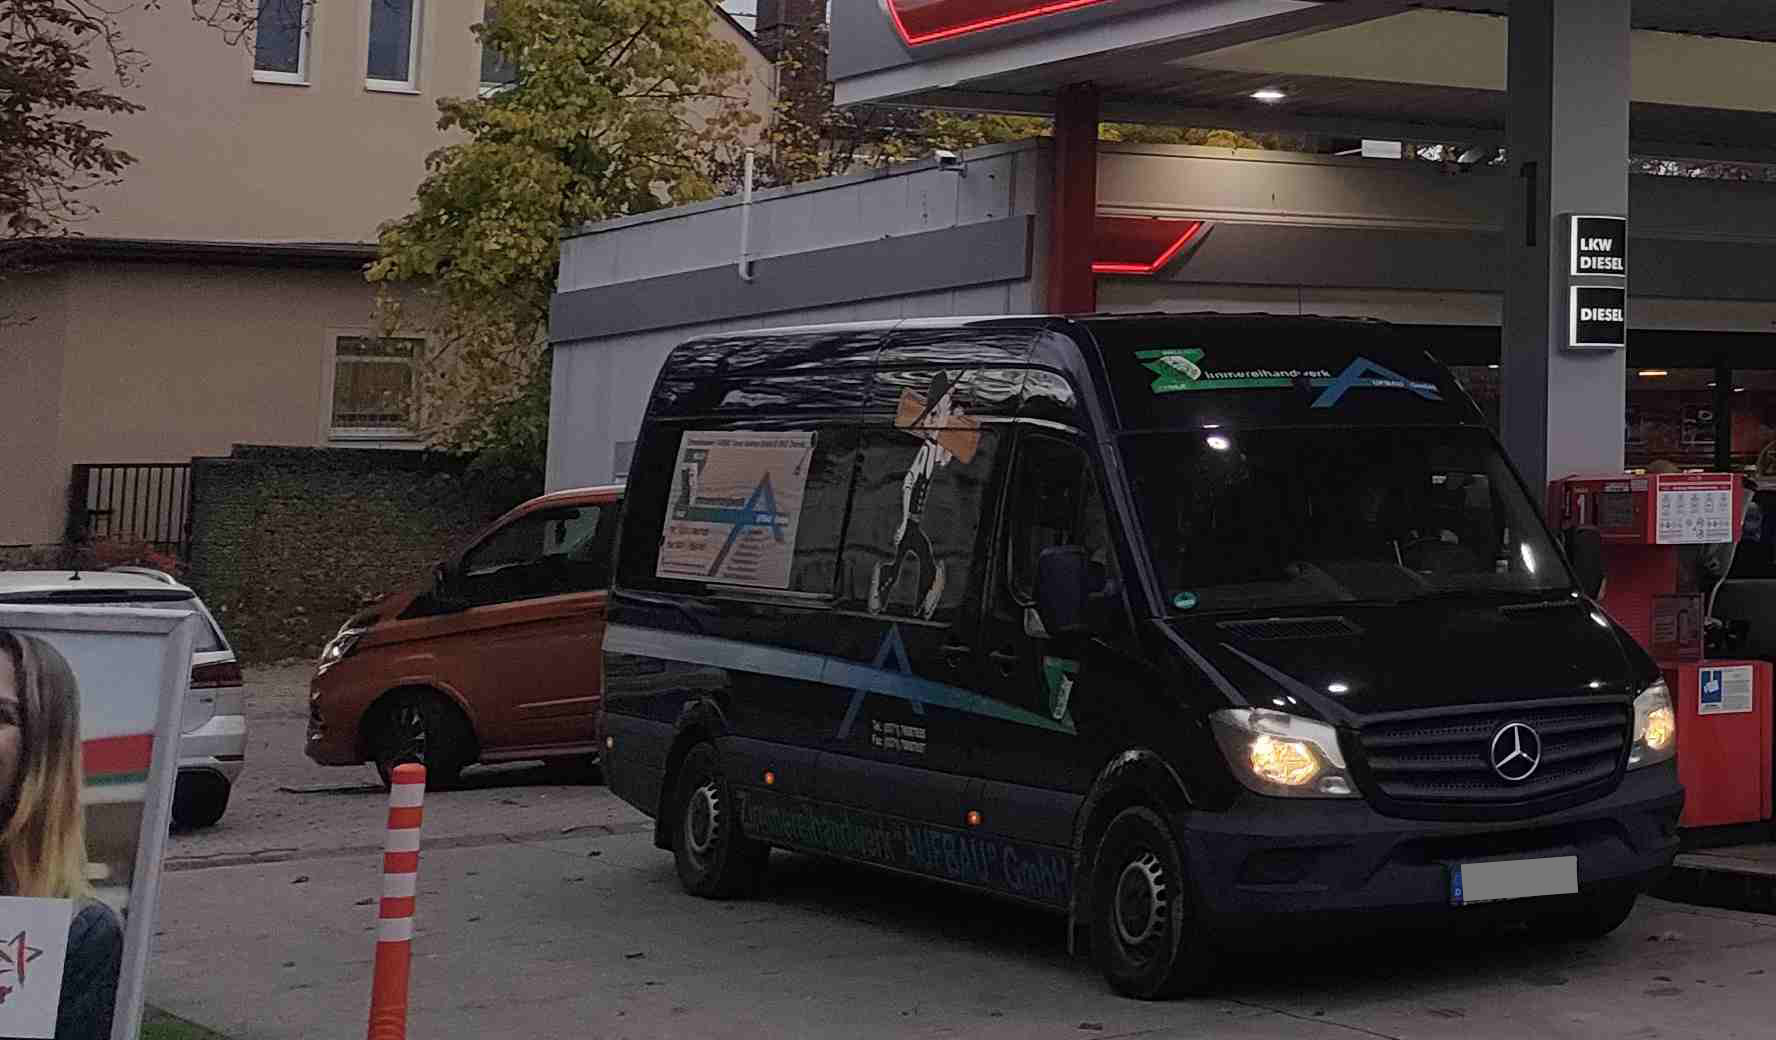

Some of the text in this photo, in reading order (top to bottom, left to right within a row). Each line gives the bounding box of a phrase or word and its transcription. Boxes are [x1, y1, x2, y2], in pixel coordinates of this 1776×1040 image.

[1579, 237, 1613, 252] LKW
[1579, 256, 1625, 271] DIESEL
[1579, 307, 1625, 322] DIESEL
